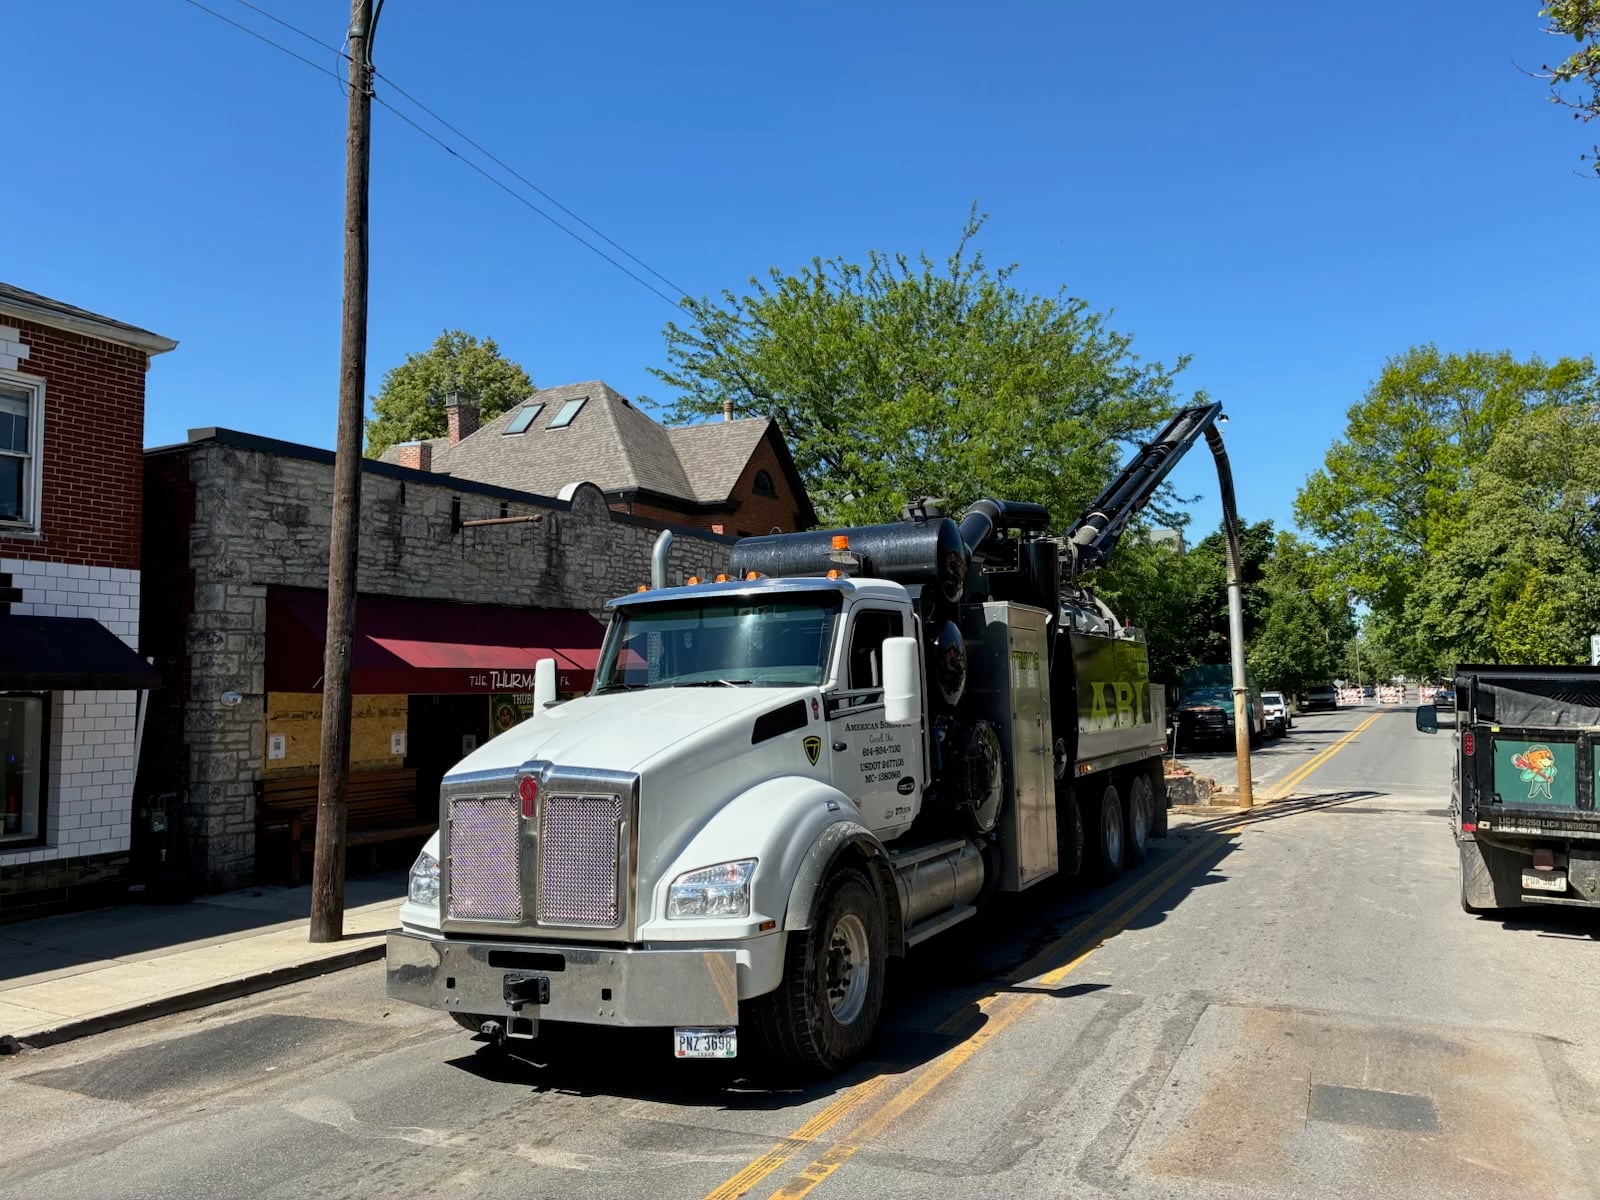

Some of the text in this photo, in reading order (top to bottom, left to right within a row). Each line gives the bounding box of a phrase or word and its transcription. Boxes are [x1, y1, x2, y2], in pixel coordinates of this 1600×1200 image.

[469, 674, 488, 687] THE
[488, 670, 536, 690] THURMA
[1088, 681, 1145, 735] ABI
[845, 722, 878, 732] AMERICAN
[860, 761, 881, 772] USDOT
[679, 1035, 732, 1052] PNZ 3698
